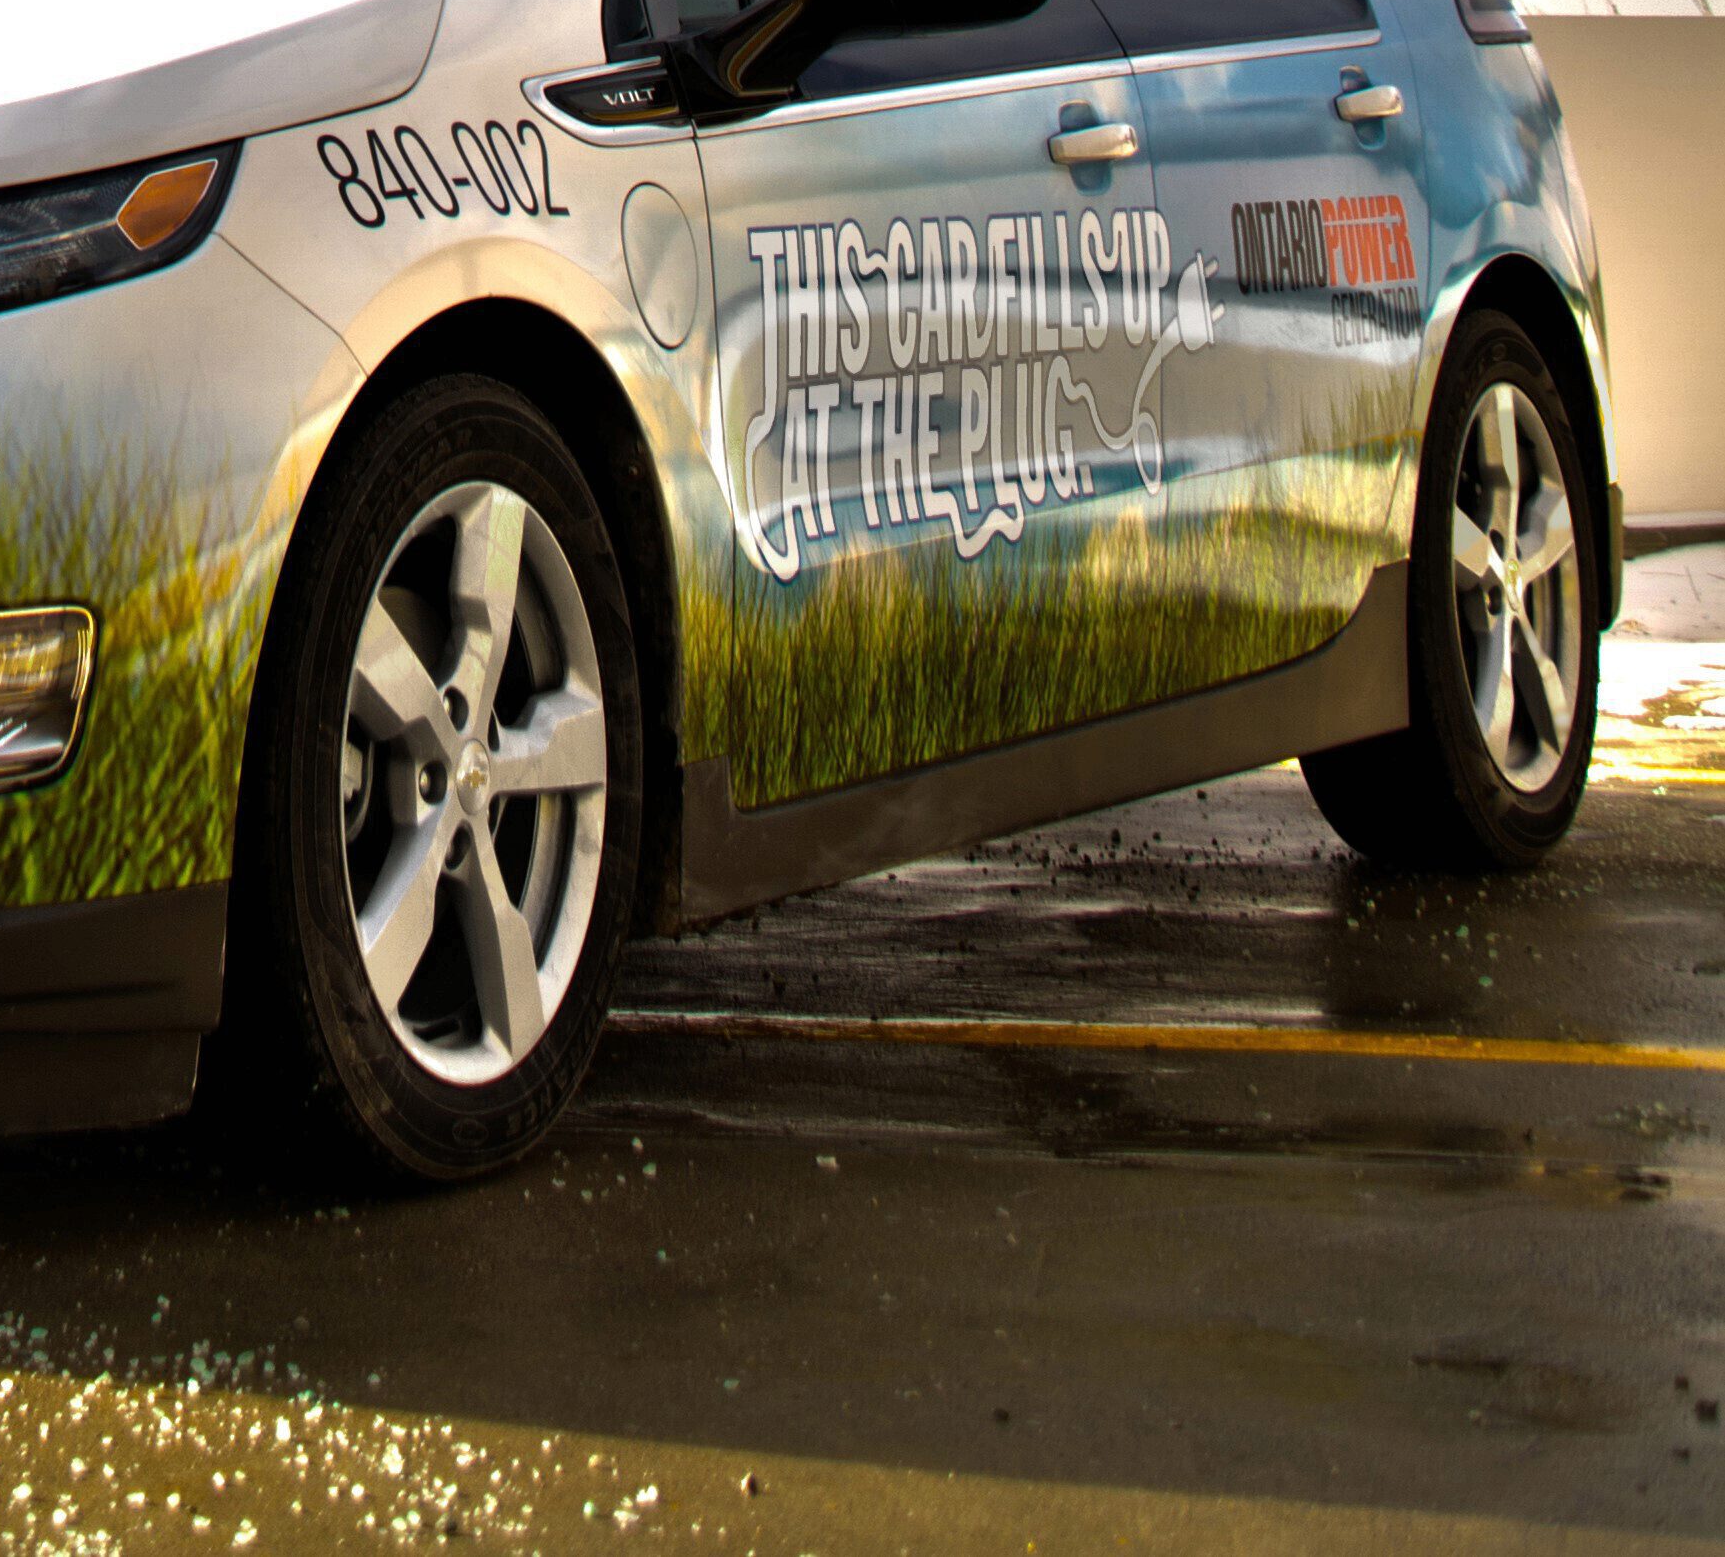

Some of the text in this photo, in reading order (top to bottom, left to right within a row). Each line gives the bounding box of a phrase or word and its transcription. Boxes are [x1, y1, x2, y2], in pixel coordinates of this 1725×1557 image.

[602, 87, 656, 106] VOLT
[316, 119, 570, 228] 840-002
[748, 207, 1171, 378] THIS CAR FILLS UP
[1331, 286, 1422, 347] GENERATION
[781, 356, 1095, 543] AT THE PLUG.
